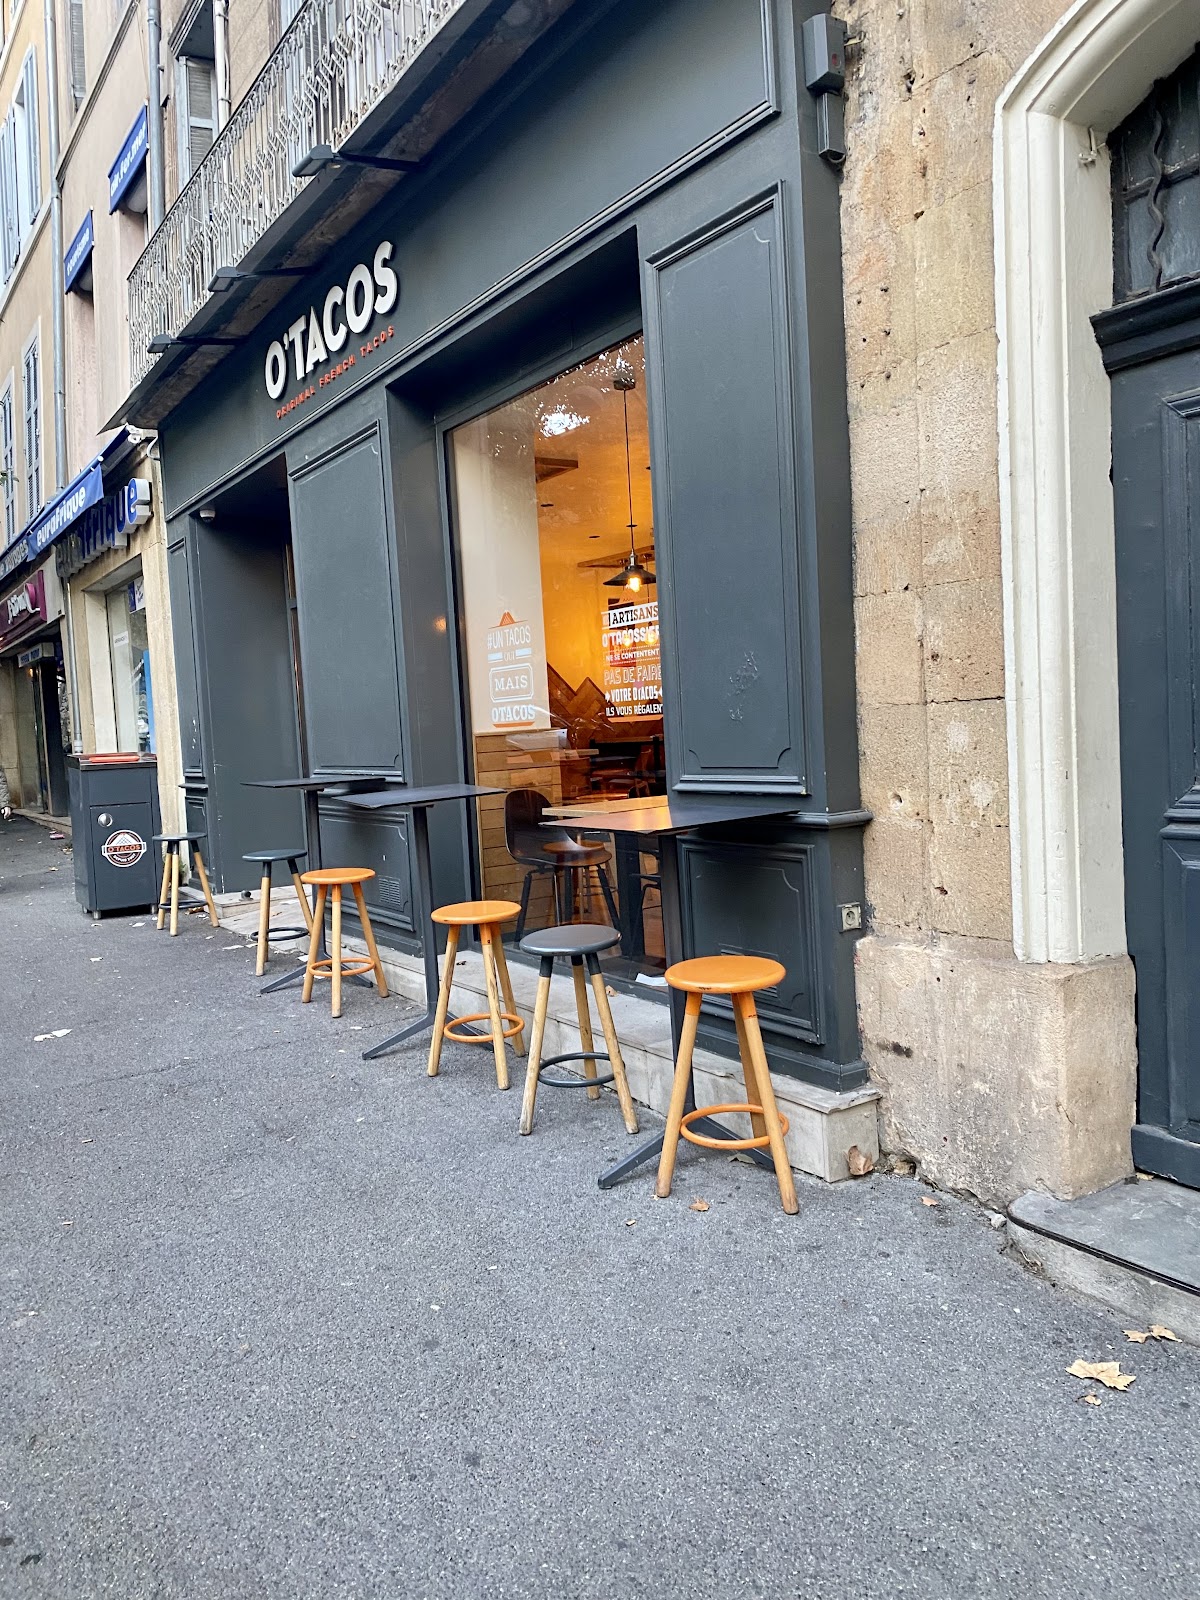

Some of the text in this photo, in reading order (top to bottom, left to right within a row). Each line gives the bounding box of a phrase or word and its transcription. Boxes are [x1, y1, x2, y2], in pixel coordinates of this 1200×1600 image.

[265, 240, 398, 400] O'TACOS
[276, 325, 395, 419] ORIGINAL FRENCH TACOS
[36, 486, 86, 547] eurafrique
[612, 605, 659, 626] ARTISANS
[487, 625, 531, 650] #UN TACOS
[614, 653, 621, 661] SE
[621, 648, 660, 660] CONTENTENT
[494, 675, 528, 691] MAIS
[604, 663, 662, 685] PAS DE FAIRE
[611, 687, 632, 703] VOTRE
[605, 706, 615, 717] ILS
[615, 706, 633, 716] VOUS
